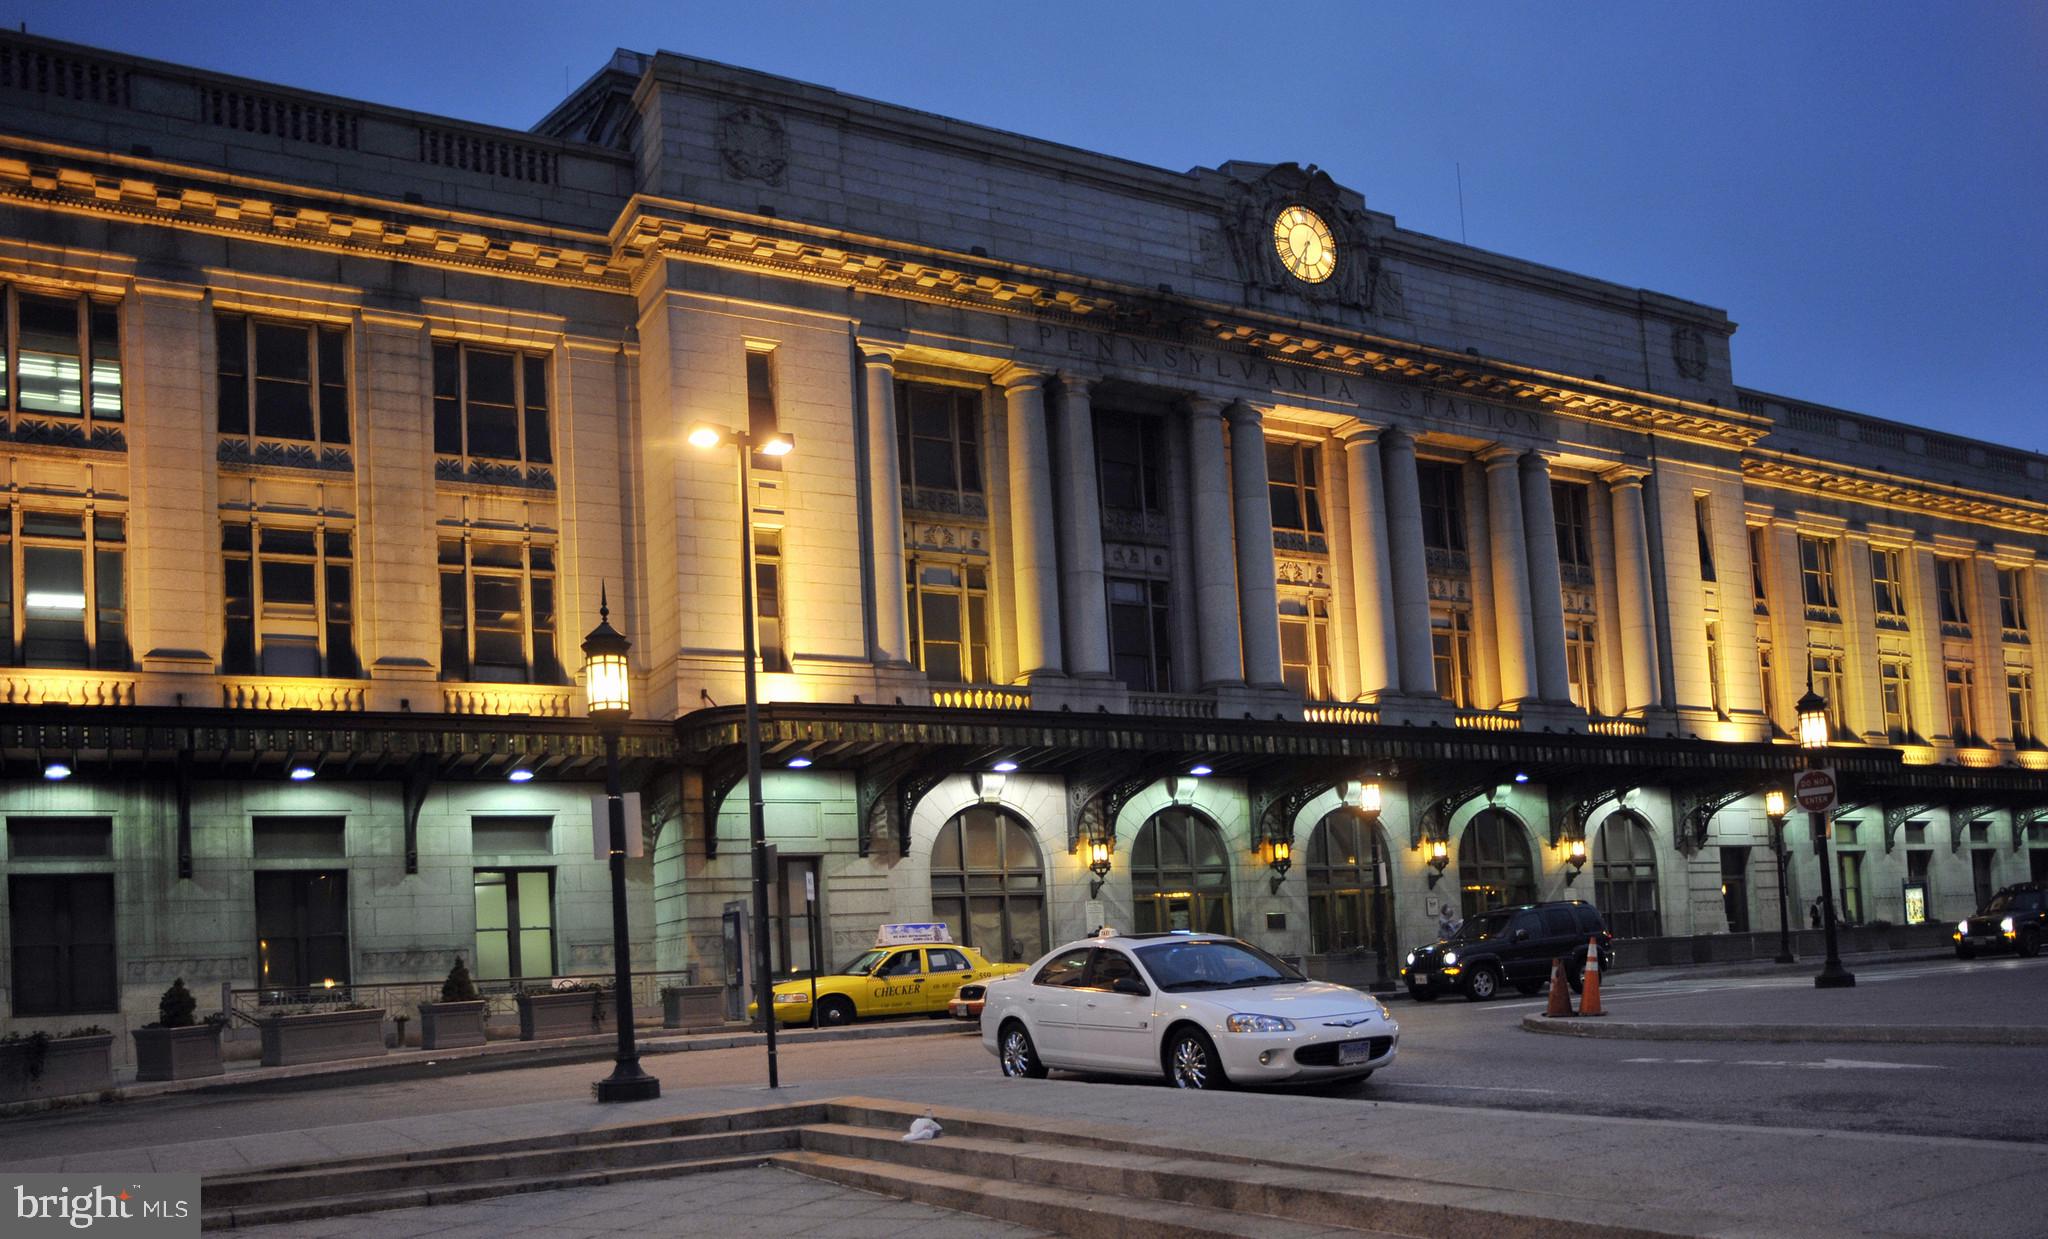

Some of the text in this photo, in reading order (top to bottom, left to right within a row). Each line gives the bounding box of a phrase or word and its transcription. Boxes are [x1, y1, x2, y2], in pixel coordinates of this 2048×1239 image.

[1039, 326, 1542, 432] PENNSYLVANIA STATION
[1801, 776, 1829, 788] DO NOT
[1805, 795, 1828, 805] ENTER
[874, 984, 921, 998] CHECKER
